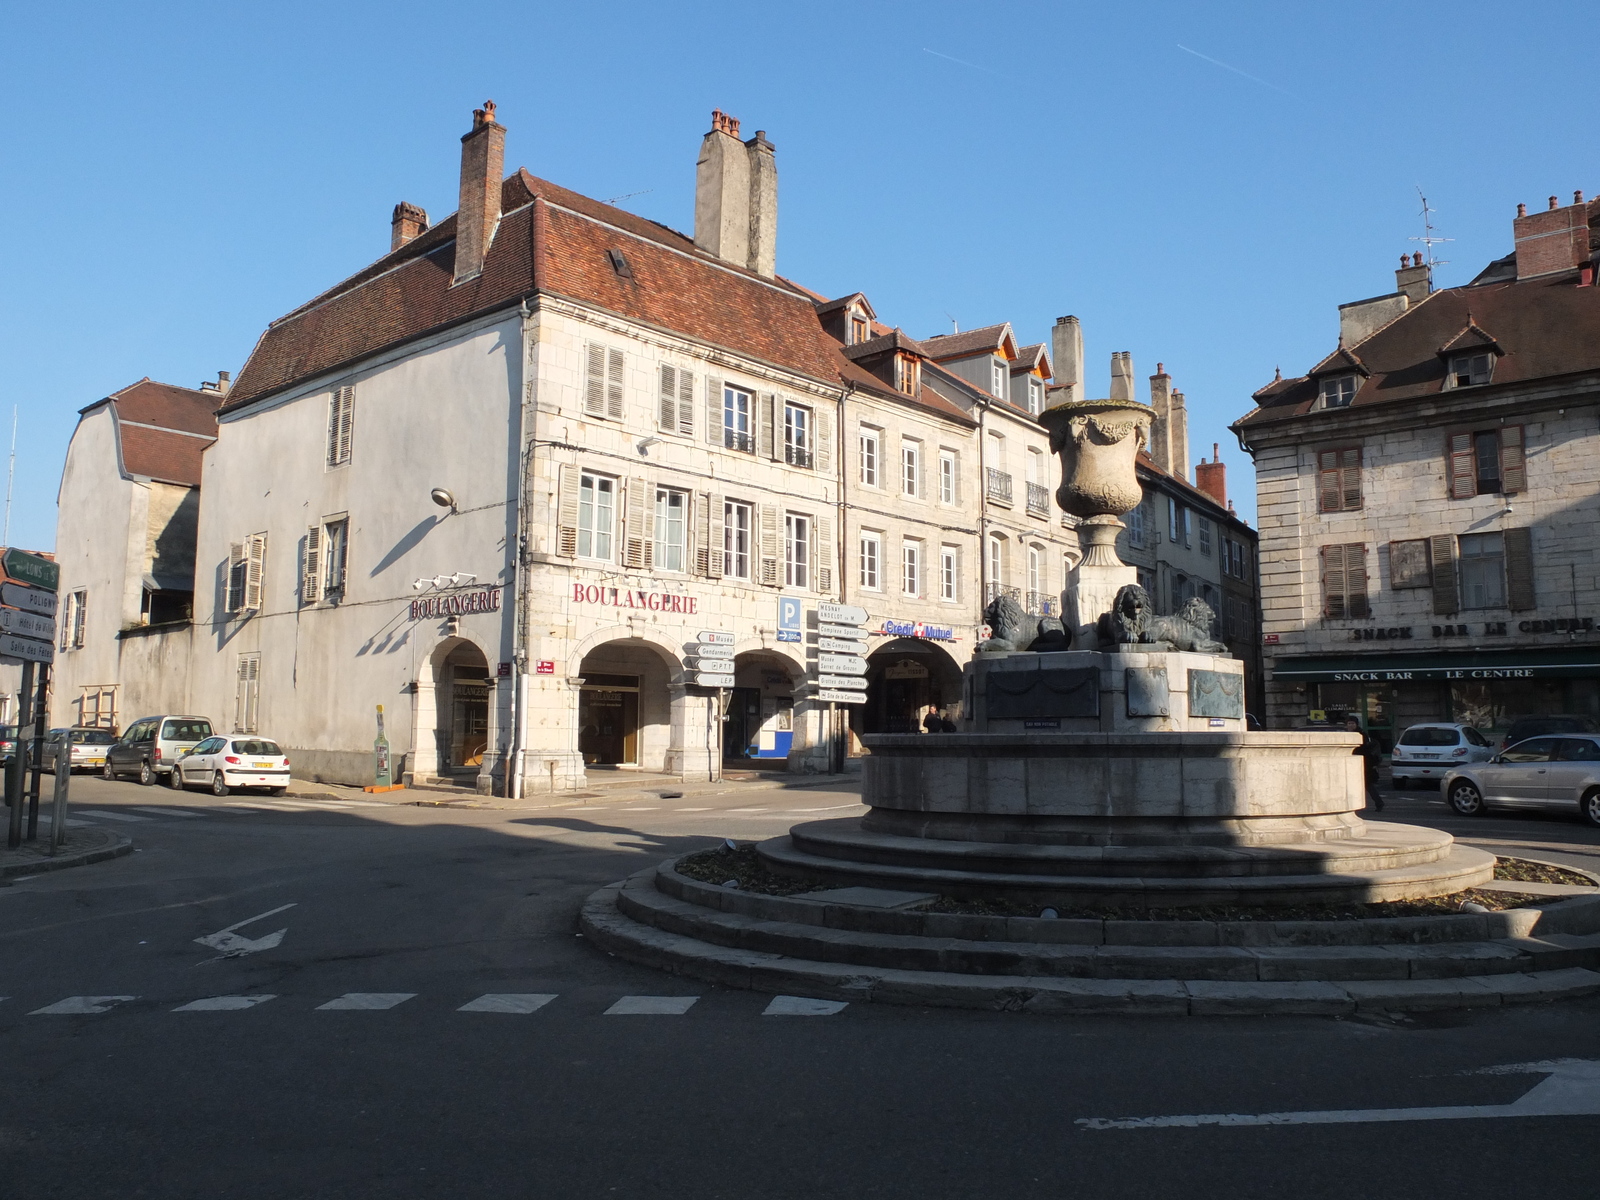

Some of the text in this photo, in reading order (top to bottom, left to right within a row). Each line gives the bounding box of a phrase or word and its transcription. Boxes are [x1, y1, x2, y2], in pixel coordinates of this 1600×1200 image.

[30, 594, 56, 609] POLIGNY
[411, 590, 501, 619] BOULANGERIE
[571, 583, 698, 614] BOULANGERIE
[785, 602, 795, 623] P
[820, 604, 841, 612] MESNAY
[820, 612, 843, 620] ANDELOT
[19, 617, 54, 634] Hôtel de Ville
[820, 626, 842, 634] Complexe
[886, 620, 953, 639] Crédit Mutuel
[1353, 618, 1593, 640] SNACK BAR LE CENTRE
[716, 635, 733, 643] Musée
[10, 640, 53, 658] Salle des Fêtes
[702, 648, 733, 656] Gendarmerie
[832, 642, 851, 650] Camping
[1334, 672, 1413, 681] SNACK BAR
[1446, 669, 1534, 679] LE CENTRE
